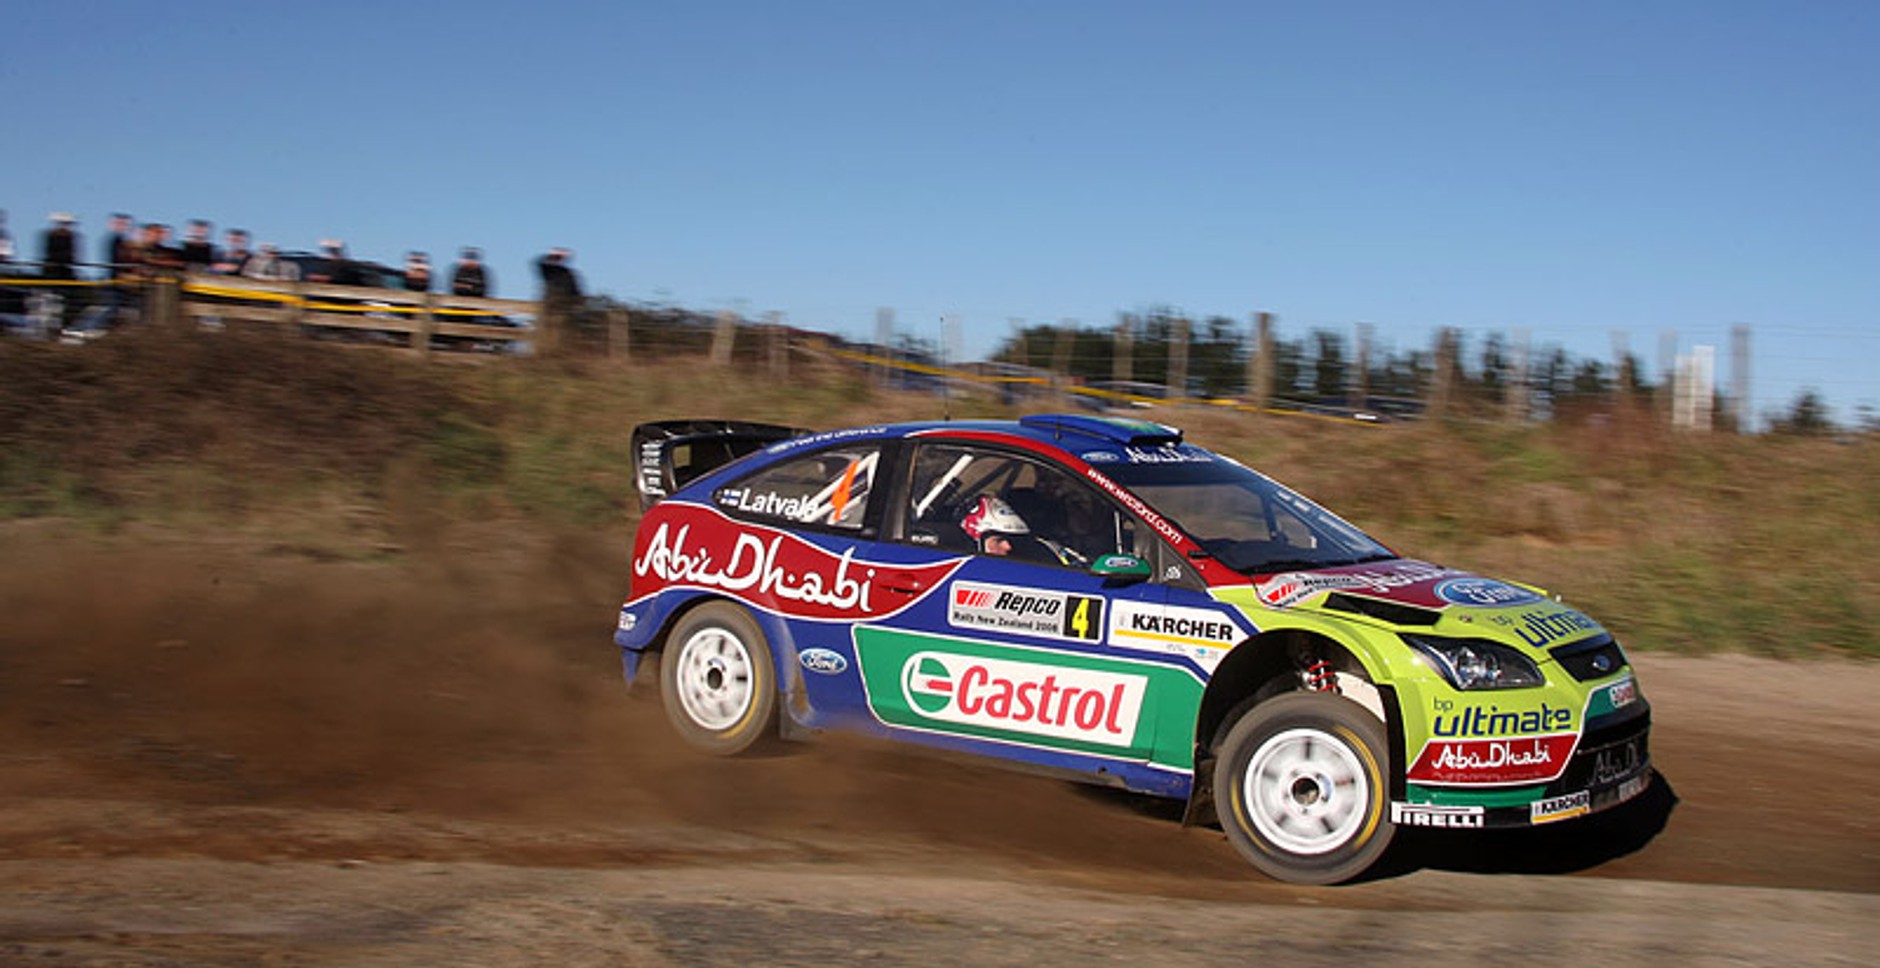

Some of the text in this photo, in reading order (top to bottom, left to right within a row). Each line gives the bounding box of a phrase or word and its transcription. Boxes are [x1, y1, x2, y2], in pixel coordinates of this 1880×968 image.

[995, 590, 1062, 617] Repco
[1071, 598, 1091, 640] 4
[1131, 612, 1233, 641] KÄRCHER
[956, 664, 1125, 735] Castrol
[1433, 697, 1454, 712] bp
[1433, 702, 1572, 737] ultimate
[1391, 801, 1484, 828] PIRELLI
